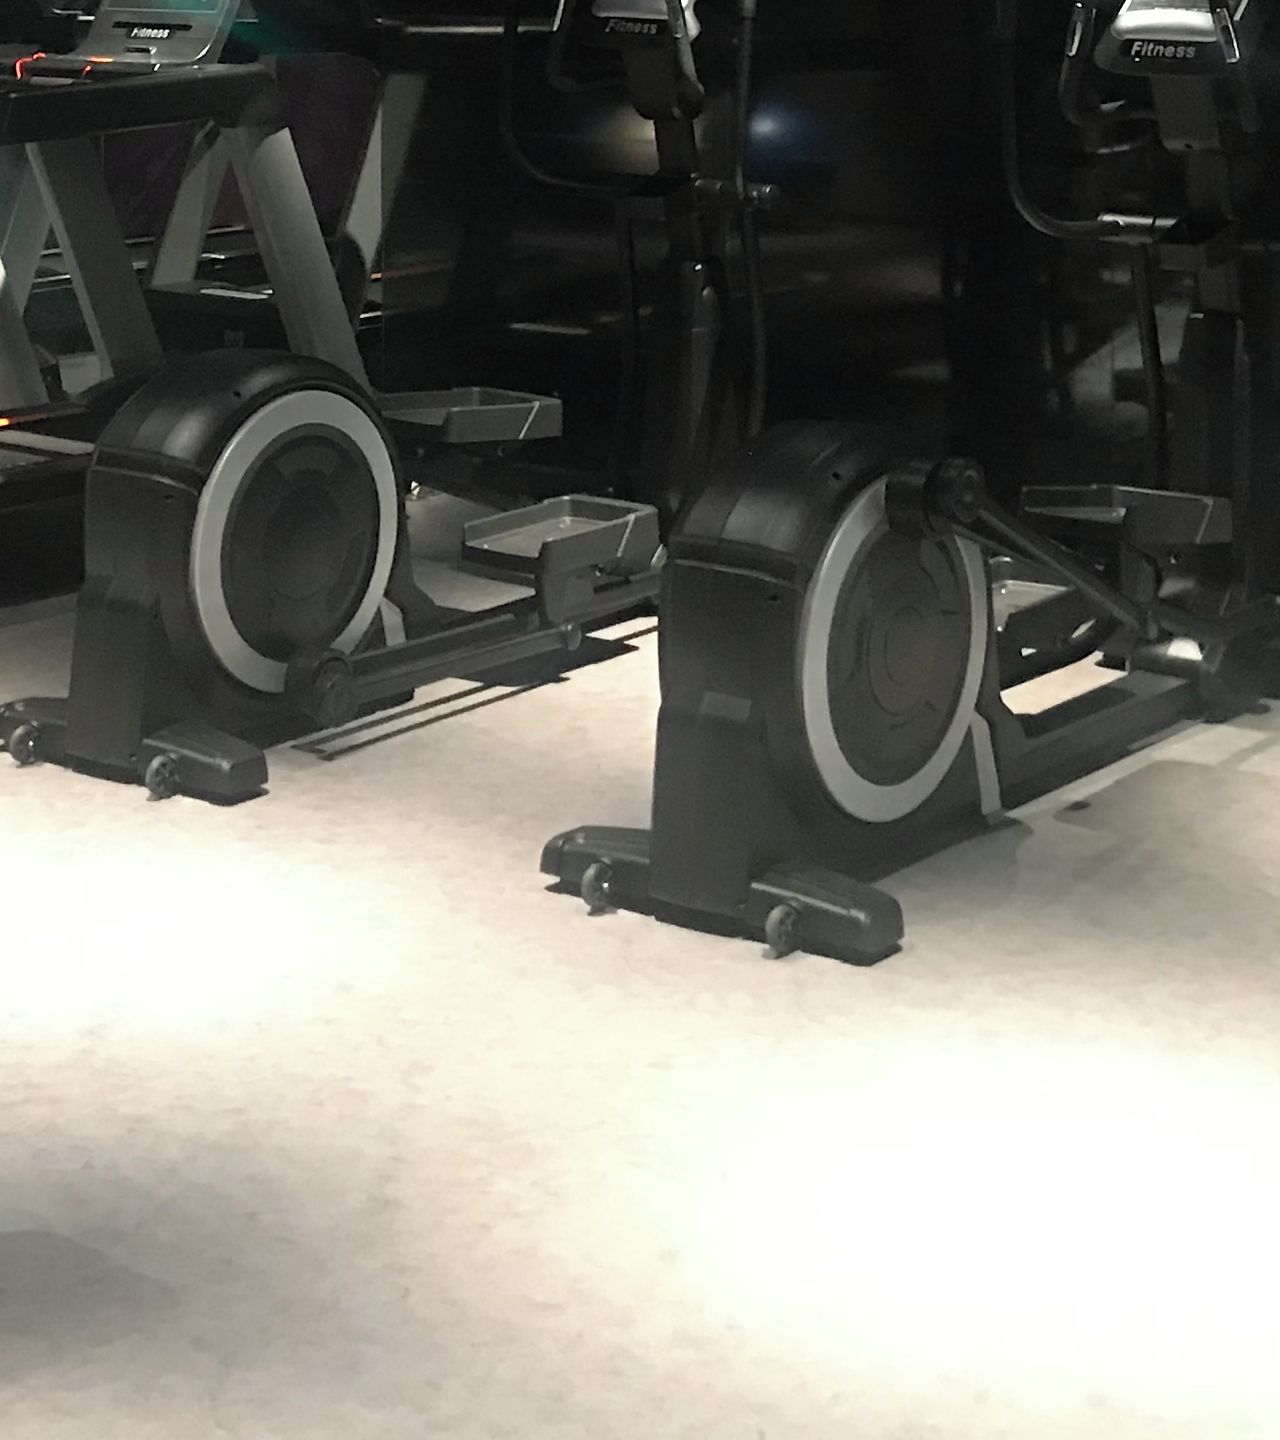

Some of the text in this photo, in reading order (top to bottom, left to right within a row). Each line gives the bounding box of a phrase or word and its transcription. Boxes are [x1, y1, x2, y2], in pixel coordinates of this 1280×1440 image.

[131, 27, 170, 39] Fitness
[604, 19, 658, 35] Fitness
[1130, 41, 1197, 59] Fitness
